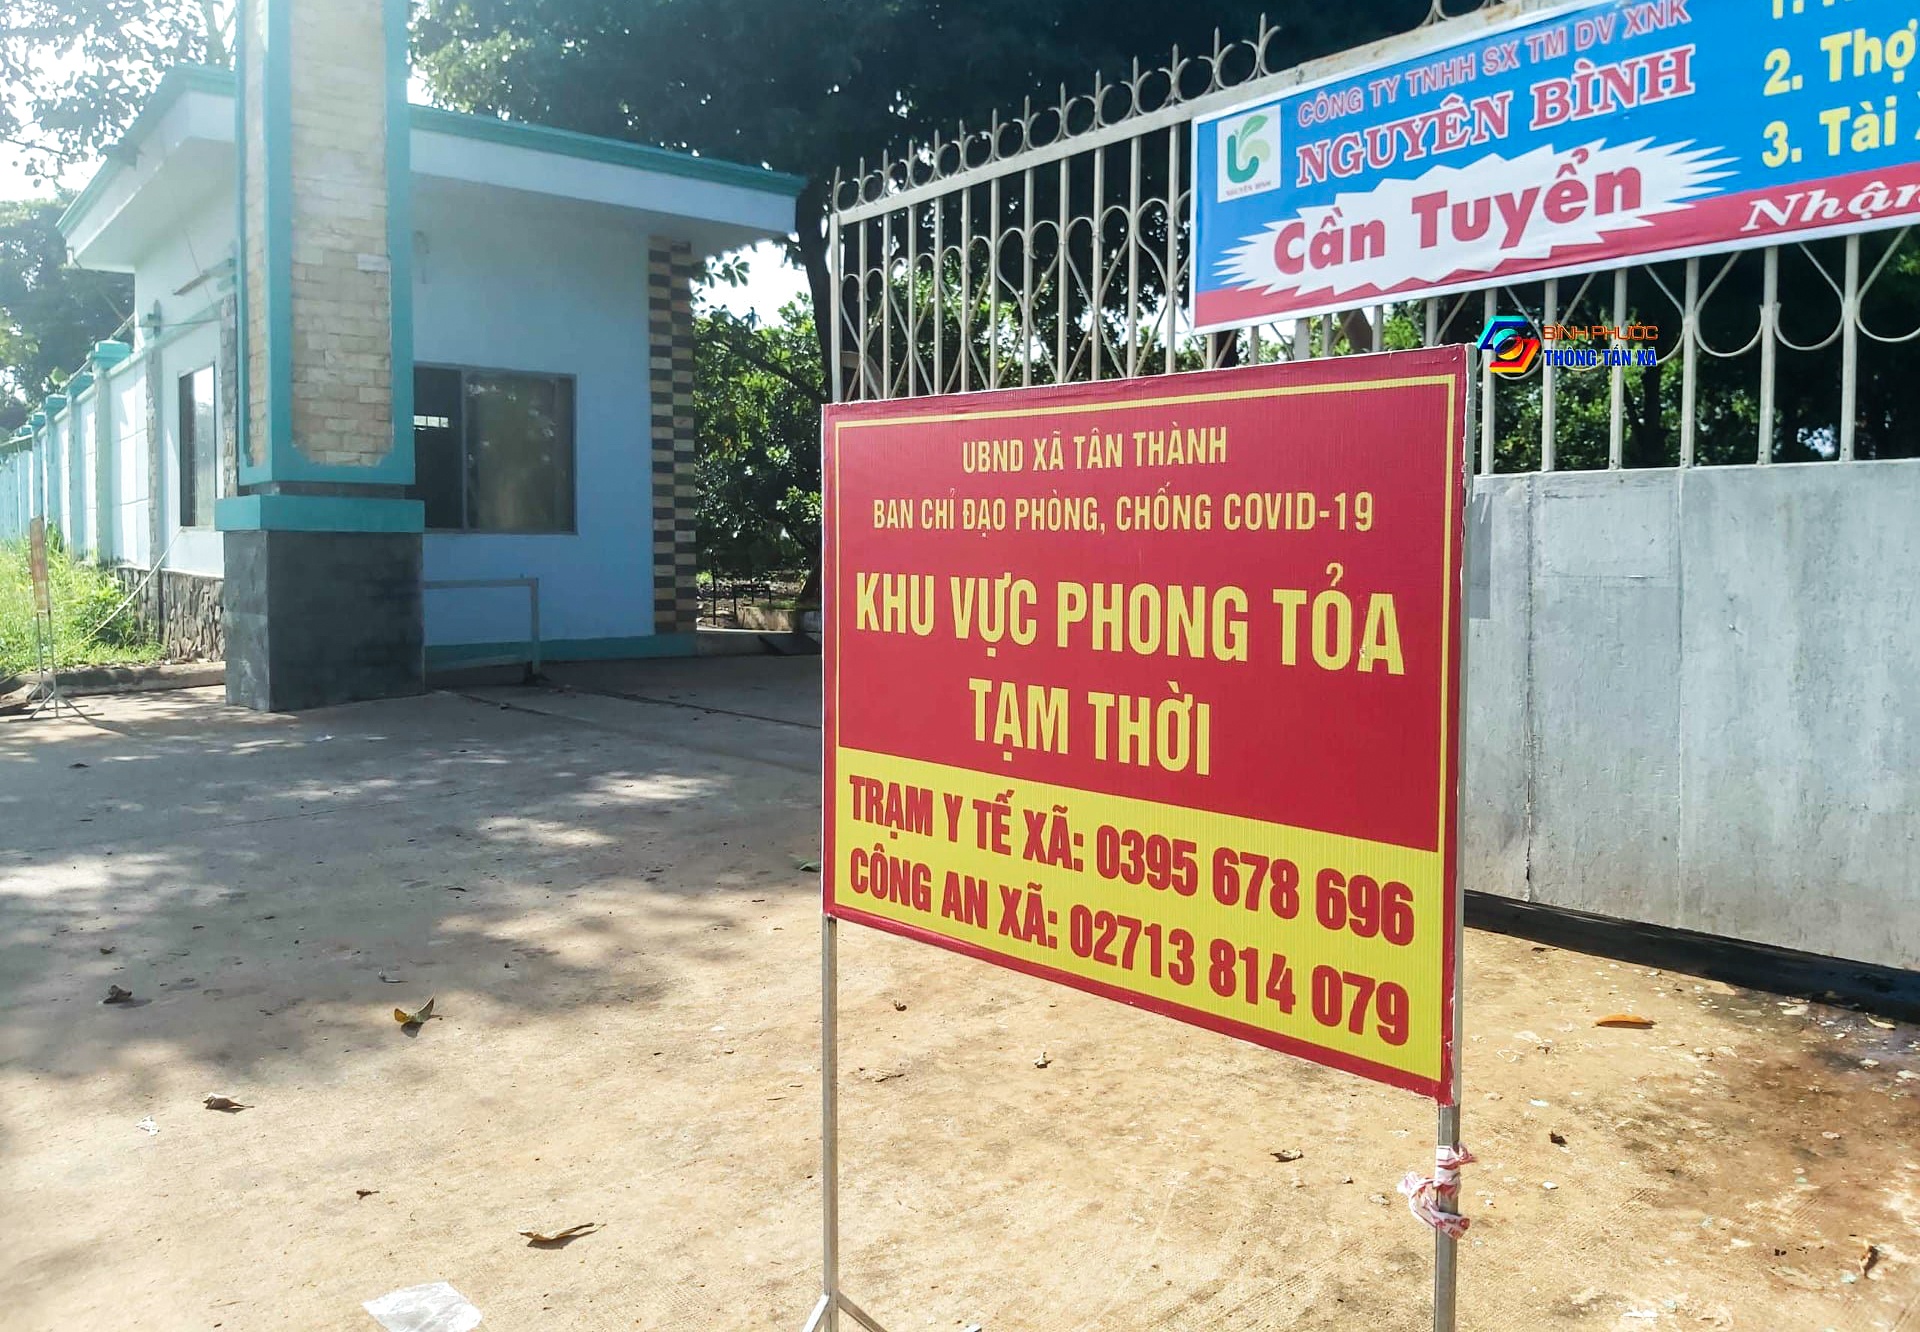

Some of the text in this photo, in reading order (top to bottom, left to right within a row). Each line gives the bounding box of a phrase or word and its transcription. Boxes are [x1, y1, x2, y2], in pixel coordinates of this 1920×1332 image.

[1298, 0, 1692, 128] CÔNG TY TNHH SX TM DV XNK
[1763, 18, 1918, 96] 2. Thợ
[1296, 44, 1696, 188] NGUYÊN BÌNH
[1762, 120, 1802, 168] 3.
[1819, 95, 1897, 156] Tài
[1274, 148, 1642, 275] Cần Tuyển
[962, 421, 1228, 474] UBND XÃ TÂN THÀNH
[873, 480, 1373, 538] BAN CHỈ ĐẠO PHÒNG, CHỐNG COVID-19
[856, 562, 1406, 676] KHU VỰC PHONG TỎA
[969, 678, 1211, 776] TẠM THỜI
[849, 774, 1415, 947] TRẠM Y TẾ XÃ: 0395 678 696
[850, 844, 1410, 1047] CÔNG AN XÃ: 02713 814 079
